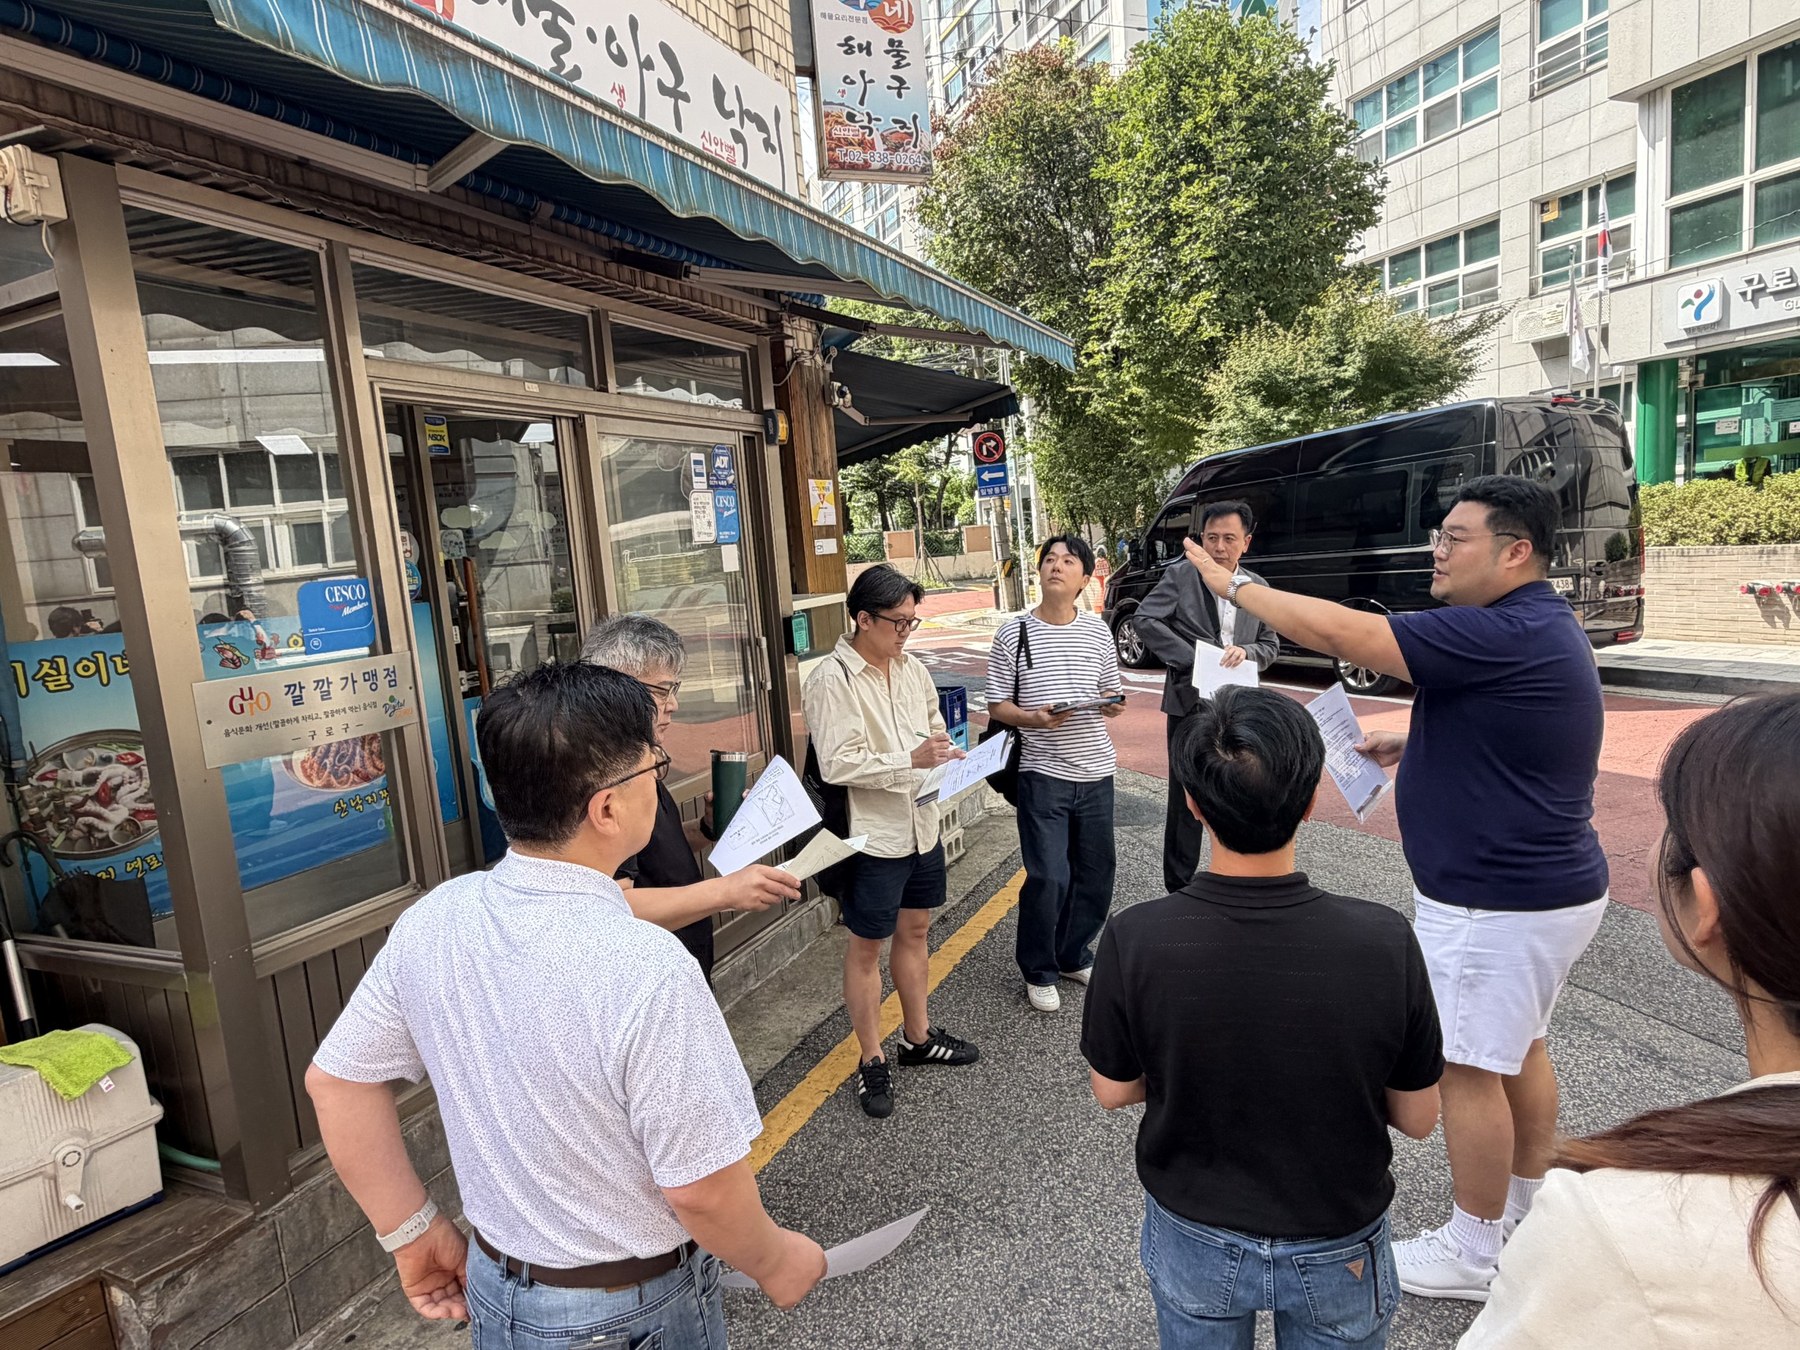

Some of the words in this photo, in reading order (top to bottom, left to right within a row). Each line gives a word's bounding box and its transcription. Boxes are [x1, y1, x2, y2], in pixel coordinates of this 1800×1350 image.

[836, 35, 912, 70] 해물
[610, 82, 627, 109] 생
[841, 69, 912, 107] 아구
[701, 129, 737, 166] 신안뻘
[712, 73, 786, 192] 낙지
[845, 111, 920, 149] 낙지
[837, 148, 922, 166] T.02-838-0264
[325, 583, 367, 603] CESCO
[342, 600, 369, 617] Members
[224, 724, 253, 738] 음식문화
[362, 701, 378, 711] 음식점
